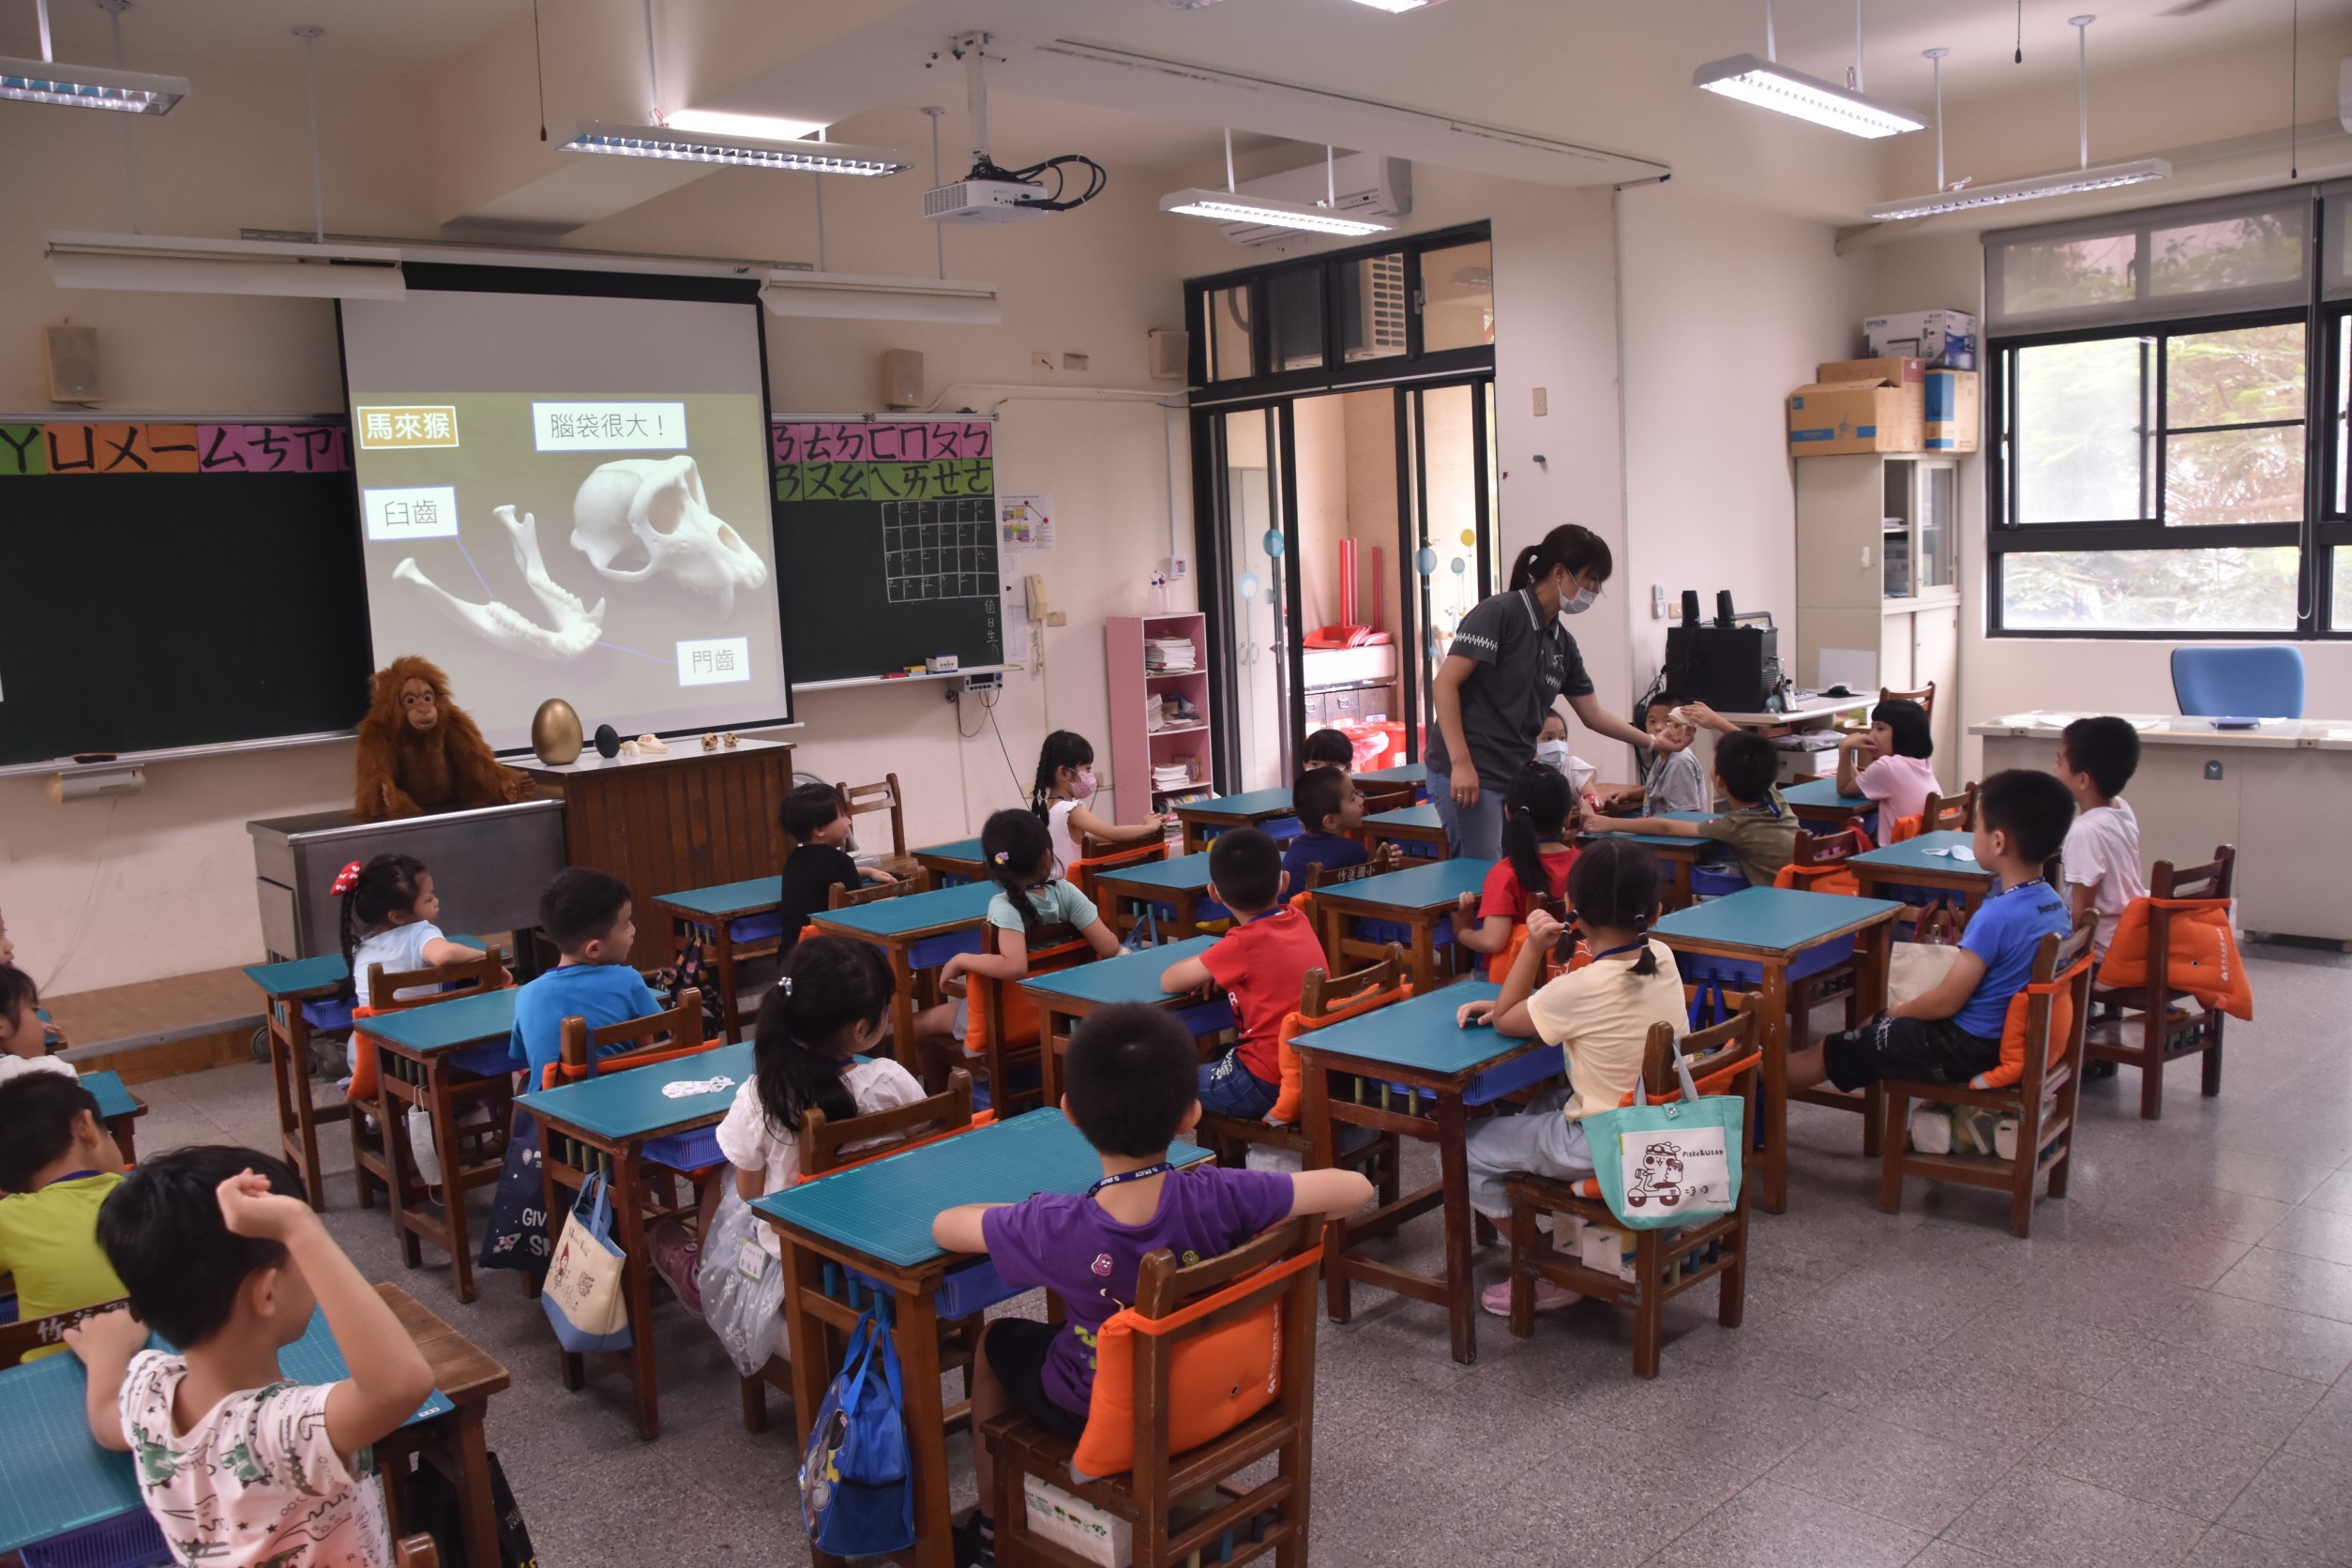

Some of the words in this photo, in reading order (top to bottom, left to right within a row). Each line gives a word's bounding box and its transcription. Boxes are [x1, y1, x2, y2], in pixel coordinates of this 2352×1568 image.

[367, 413, 450, 440] 馬來猴
[384, 499, 437, 526] 臼齒
[692, 649, 734, 674] 門齒
